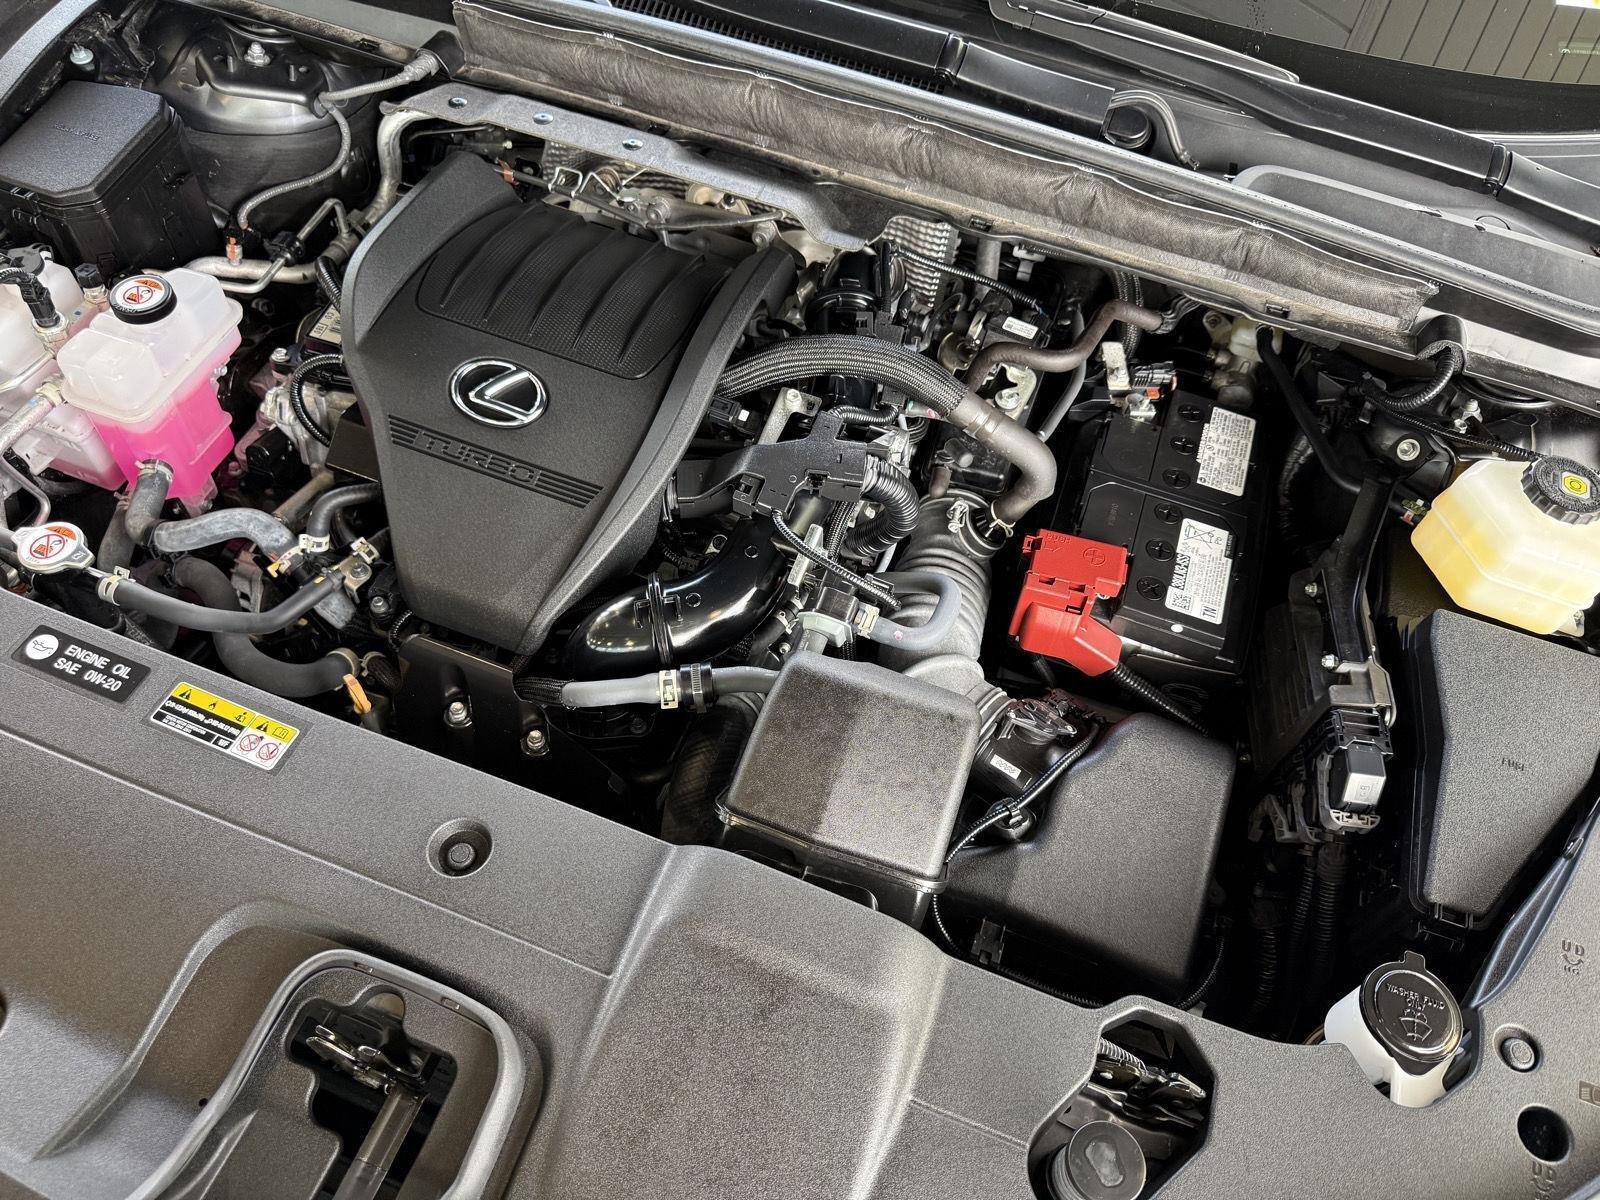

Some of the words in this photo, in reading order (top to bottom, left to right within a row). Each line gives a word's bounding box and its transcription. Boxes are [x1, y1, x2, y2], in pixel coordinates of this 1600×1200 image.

[416, 430, 541, 486] TURBO
[53, 656, 80, 677] SAE
[83, 669, 123, 693] 0W-20
[63, 644, 110, 670] ENGINE
[112, 662, 132, 680] OIL
[1386, 982, 1420, 1002] WASHER
[1422, 995, 1446, 1011] FLUID
[1406, 997, 1427, 1011] ONLY
